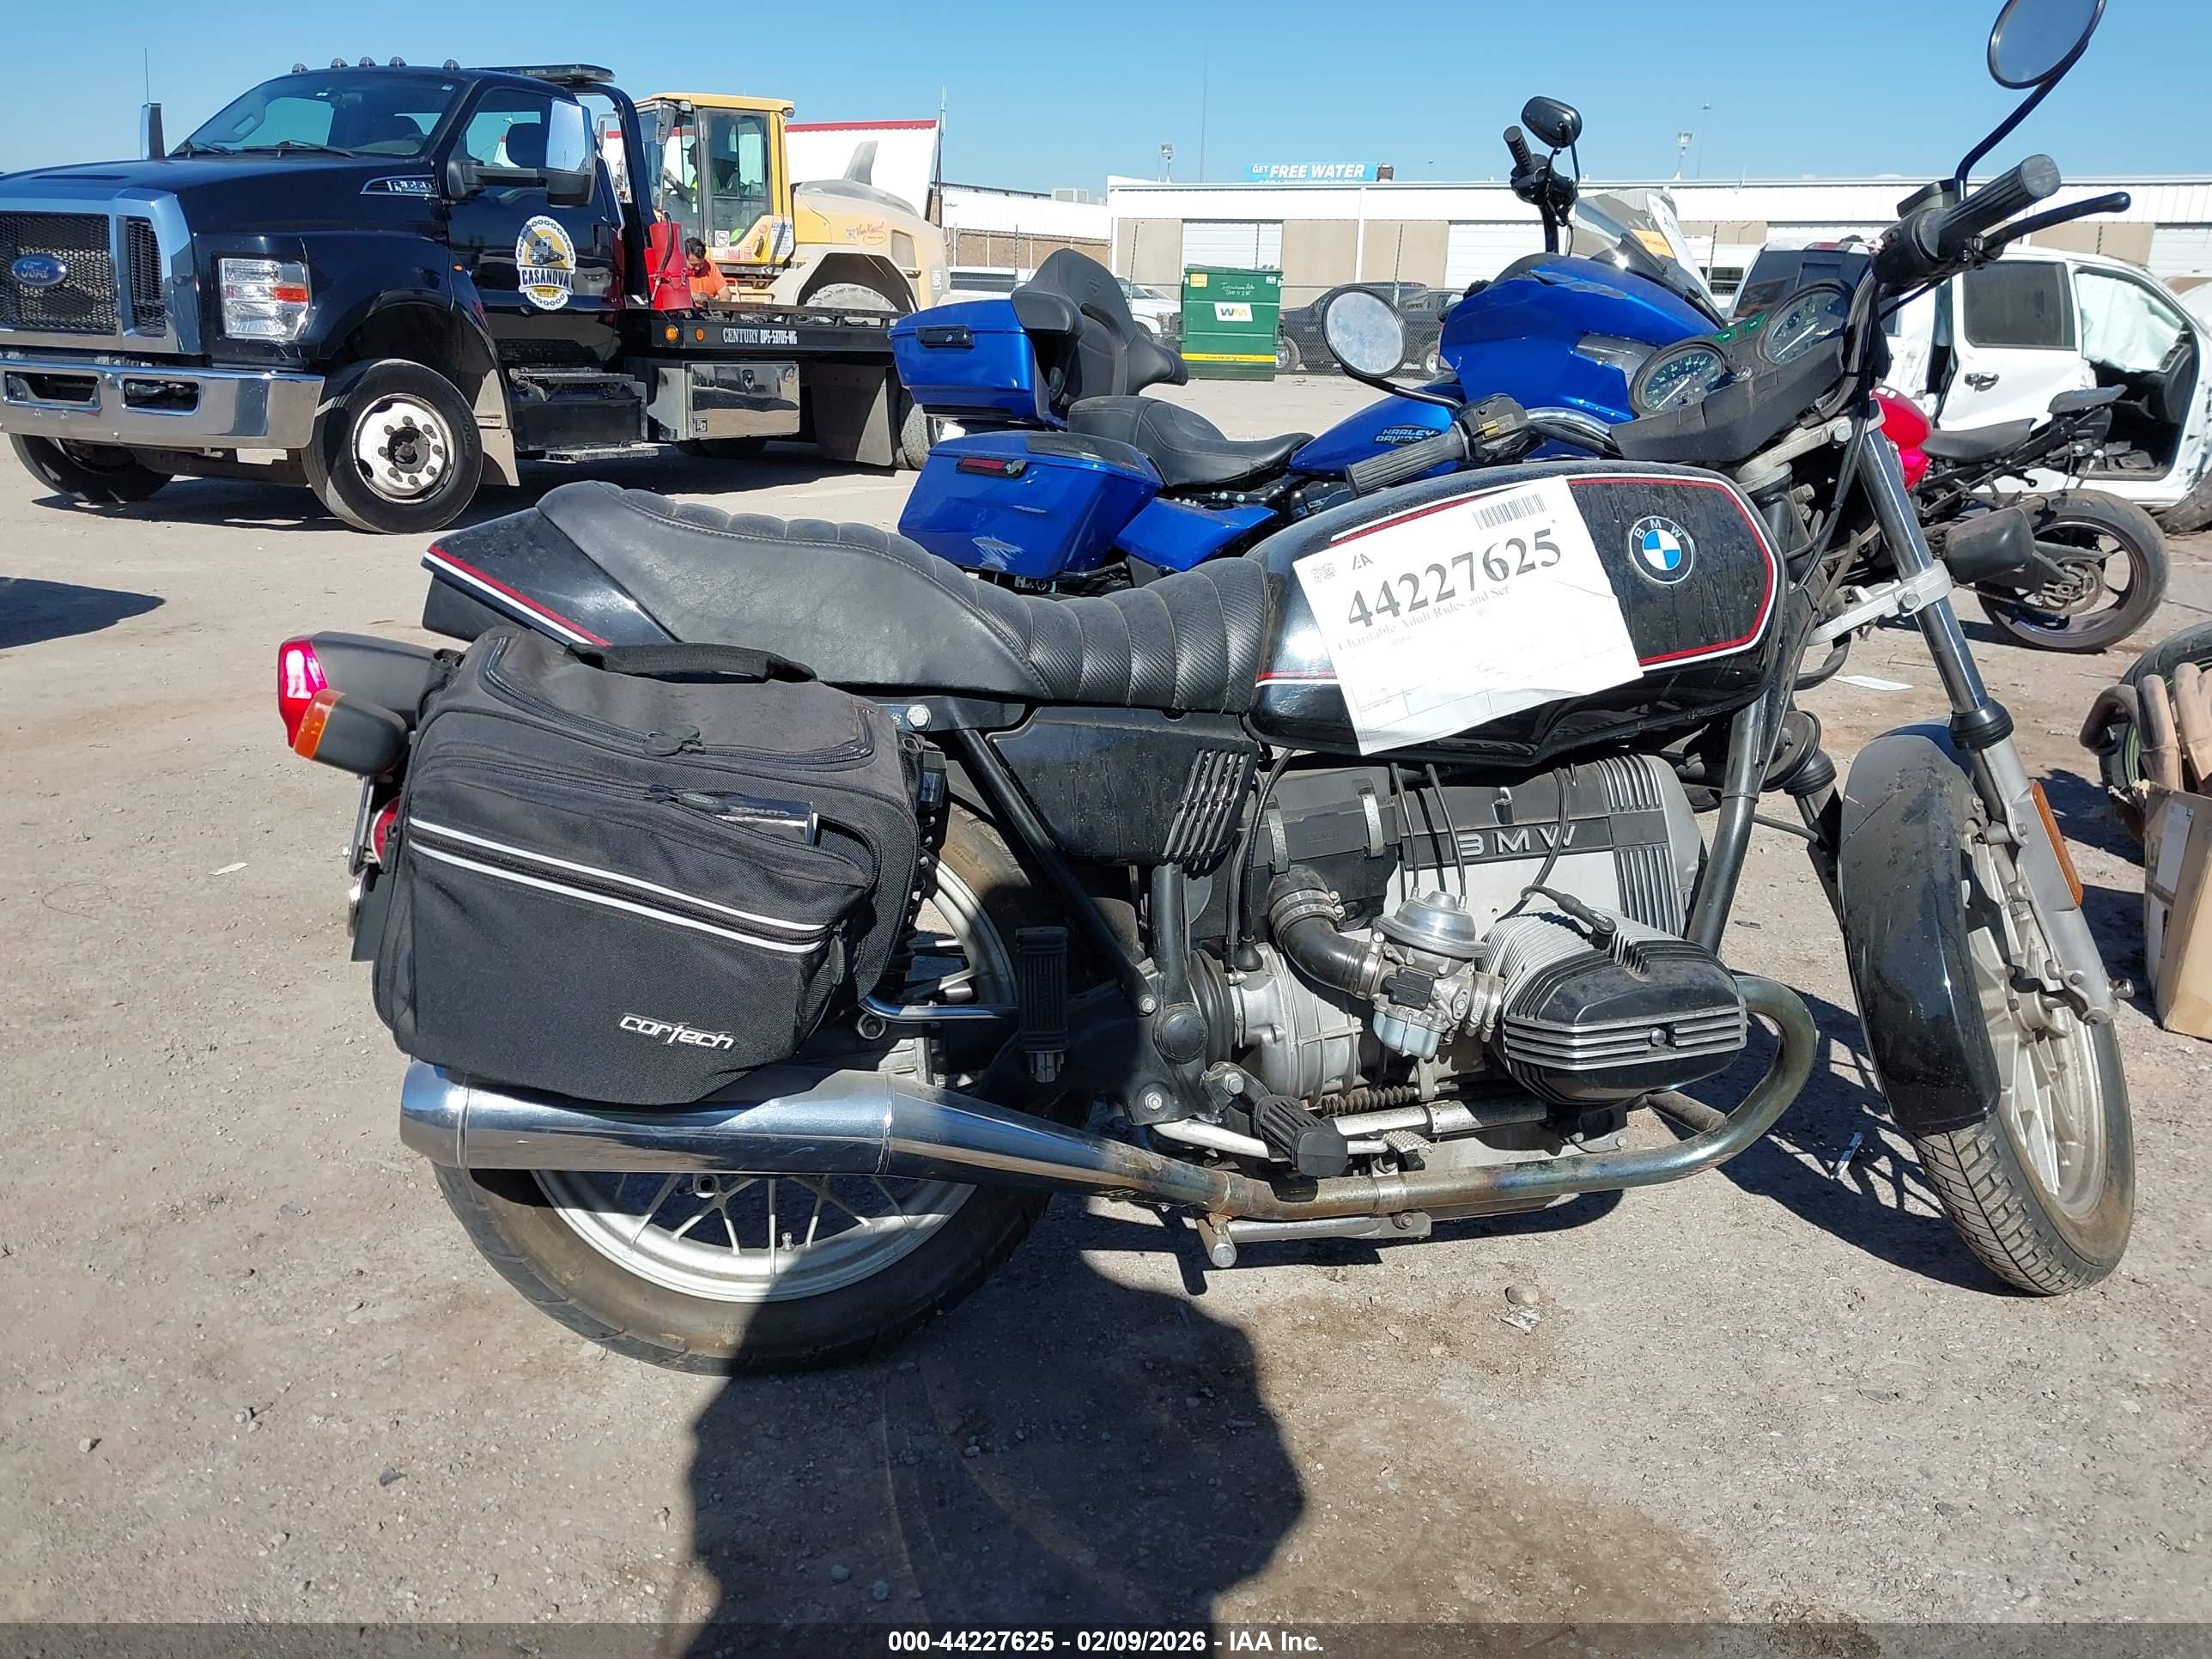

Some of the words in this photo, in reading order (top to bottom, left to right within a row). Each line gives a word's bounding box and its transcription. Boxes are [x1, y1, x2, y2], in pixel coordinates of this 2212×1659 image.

[1252, 165, 1269, 173] GET
[1269, 164, 1308, 179] FREE
[1311, 164, 1365, 179] WATER
[21, 260, 50, 279] Ford
[521, 269, 569, 287] CASANOVA
[933, 270, 942, 290] L90H
[1220, 308, 1247, 317] WM
[722, 328, 759, 343] CENTURY
[1634, 519, 1682, 539] BMW
[1348, 528, 1561, 627] 44227625
[1433, 601, 1465, 619] Rides
[1457, 825, 1577, 857] BMW
[619, 1015, 735, 1049] cortech
